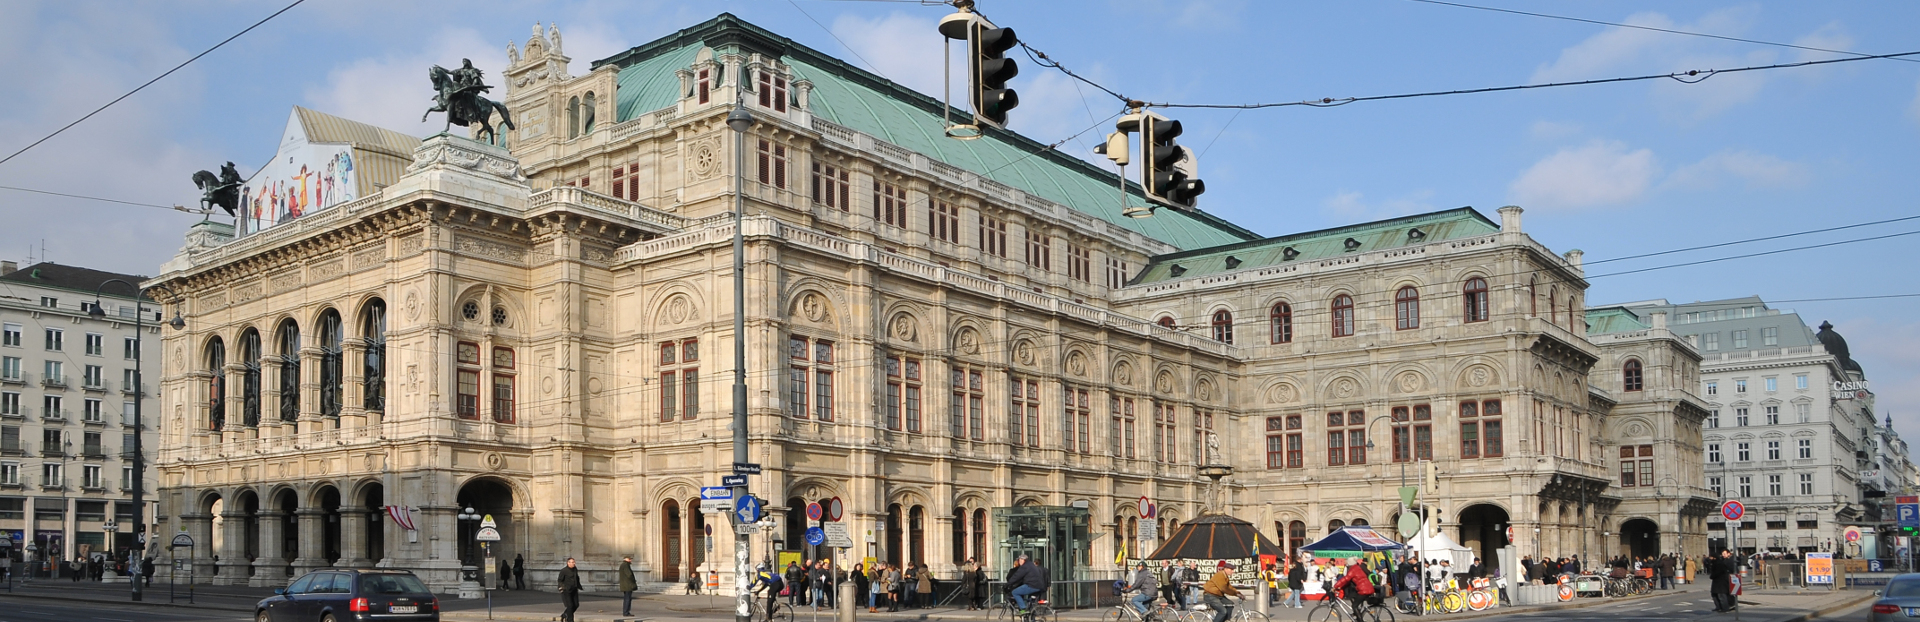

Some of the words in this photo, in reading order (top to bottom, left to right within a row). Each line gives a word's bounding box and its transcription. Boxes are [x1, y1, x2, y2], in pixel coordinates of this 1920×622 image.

[1833, 380, 1869, 391] CASINO
[1835, 391, 1855, 399] WIEN
[1900, 508, 1913, 521] P
